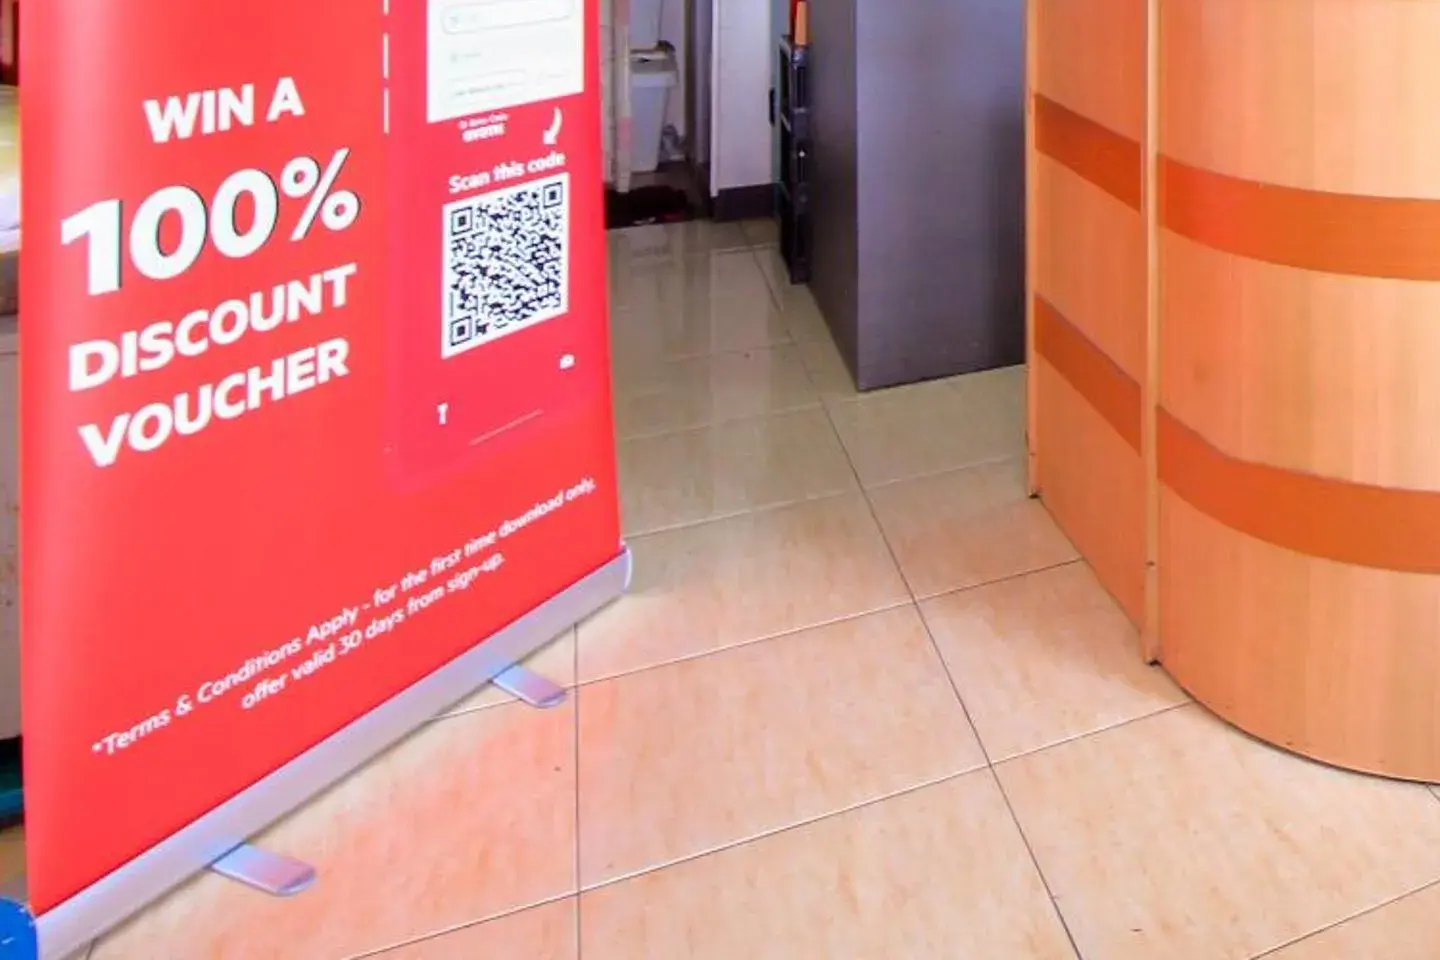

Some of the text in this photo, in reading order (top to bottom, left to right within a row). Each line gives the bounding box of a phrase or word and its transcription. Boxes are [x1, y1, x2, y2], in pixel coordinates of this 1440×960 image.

[144, 77, 305, 143] WIN A
[449, 152, 566, 194] Scan this code
[61, 148, 362, 295] 100%
[69, 263, 356, 391] DISCOUNT
[78, 338, 350, 468] VOUCHER
[175, 695, 192, 717] &
[197, 637, 301, 704] Conditions
[306, 605, 358, 645] Apply
[373, 583, 397, 608] for
[402, 567, 427, 591] the
[430, 550, 462, 578] first
[464, 530, 496, 558] time
[498, 491, 564, 539] download
[565, 477, 597, 502] only.
[241, 553, 506, 709] offer valid 30 days from sign-up.
